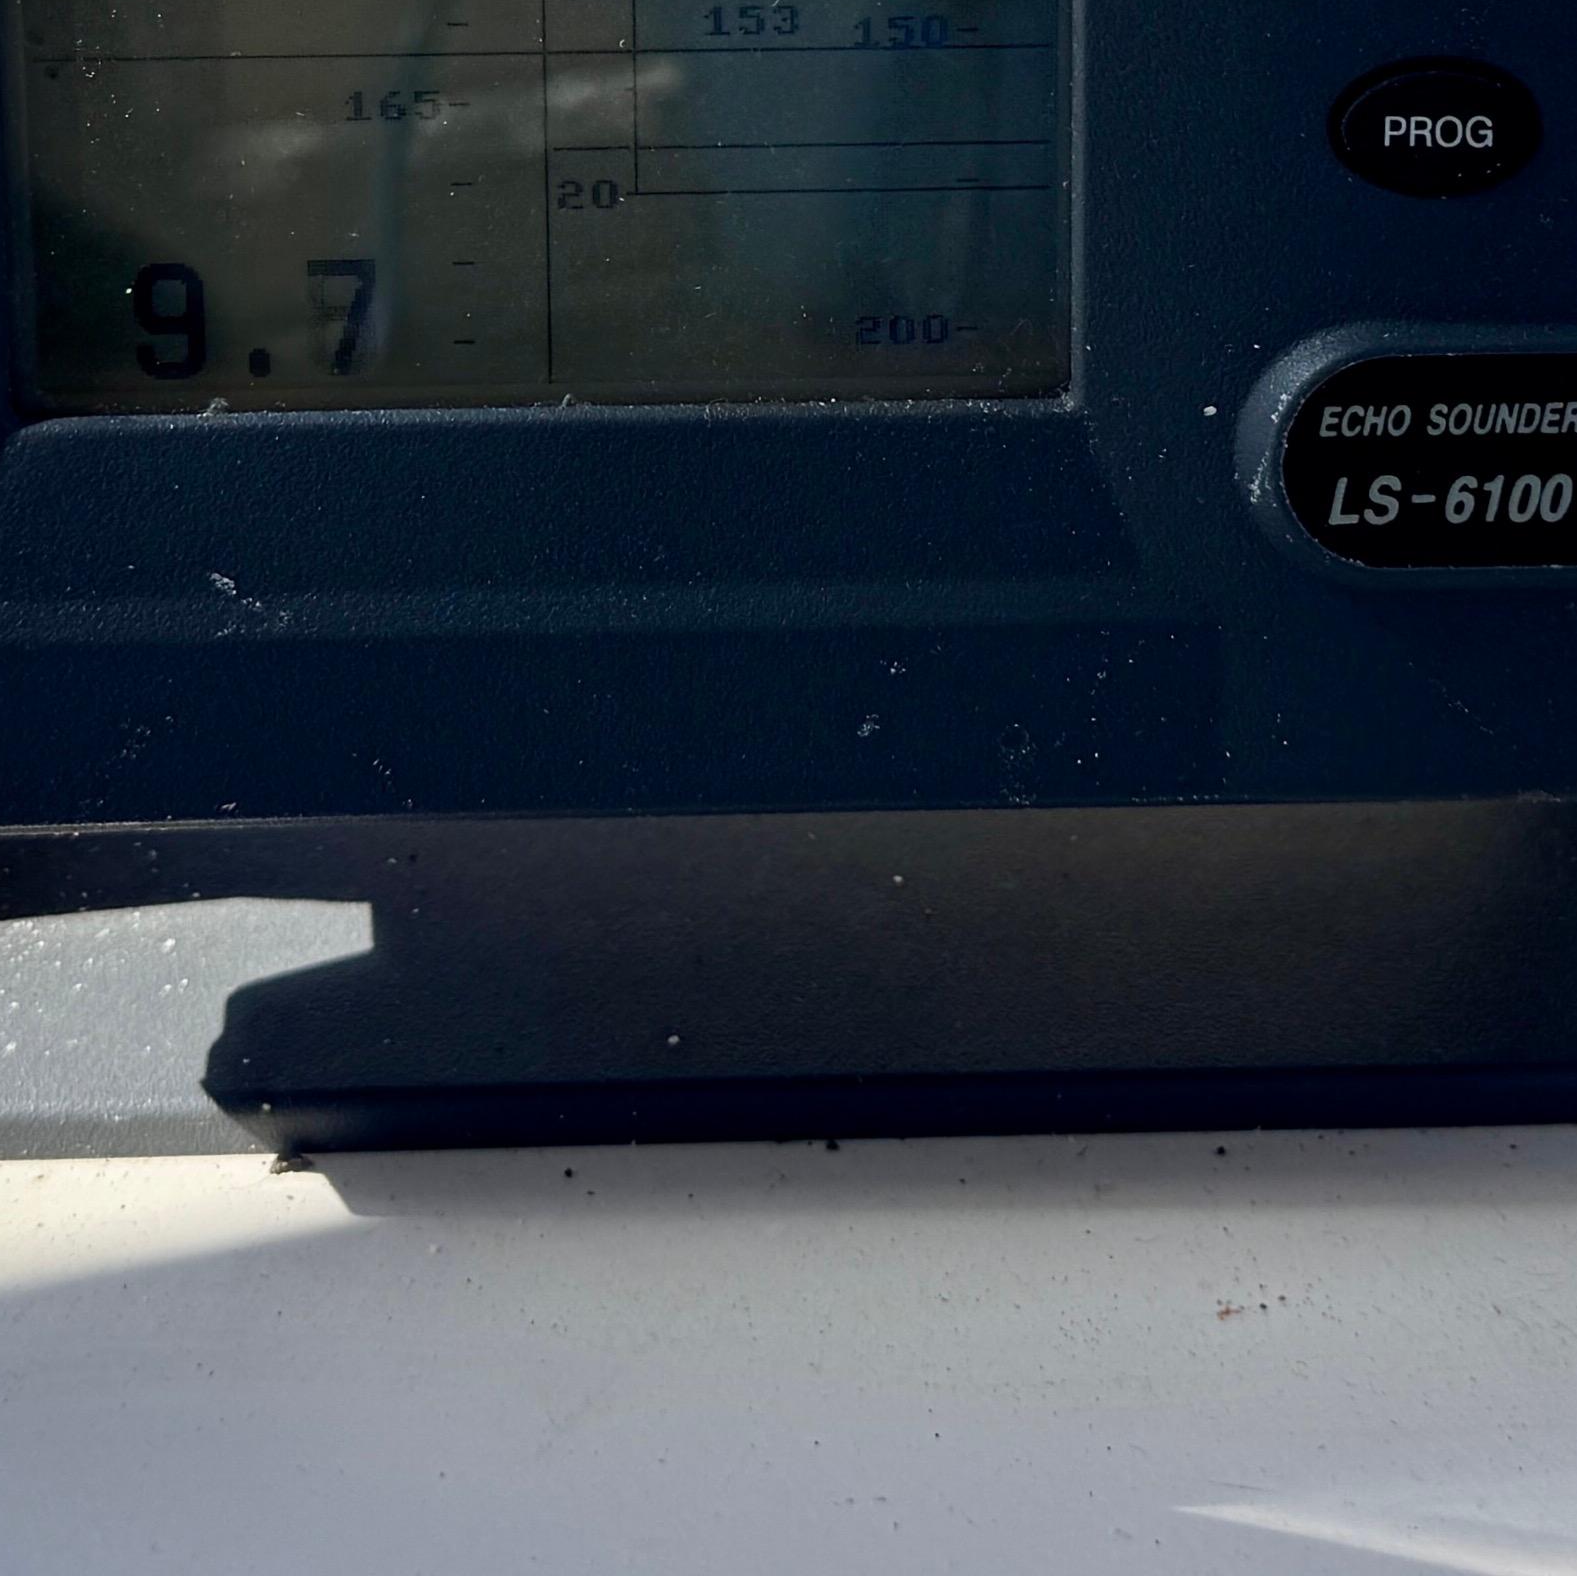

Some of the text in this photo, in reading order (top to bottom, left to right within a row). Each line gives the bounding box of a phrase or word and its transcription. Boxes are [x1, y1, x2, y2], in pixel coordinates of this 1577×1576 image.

[704, 4, 800, 37] 153
[344, 90, 441, 122] 165
[1383, 115, 1494, 149] PROG
[556, 179, 620, 210] 20
[133, 259, 376, 380] 9.7
[855, 314, 950, 346] 200
[1319, 404, 1412, 438] ECHO
[1328, 473, 1574, 526] LS-6100
